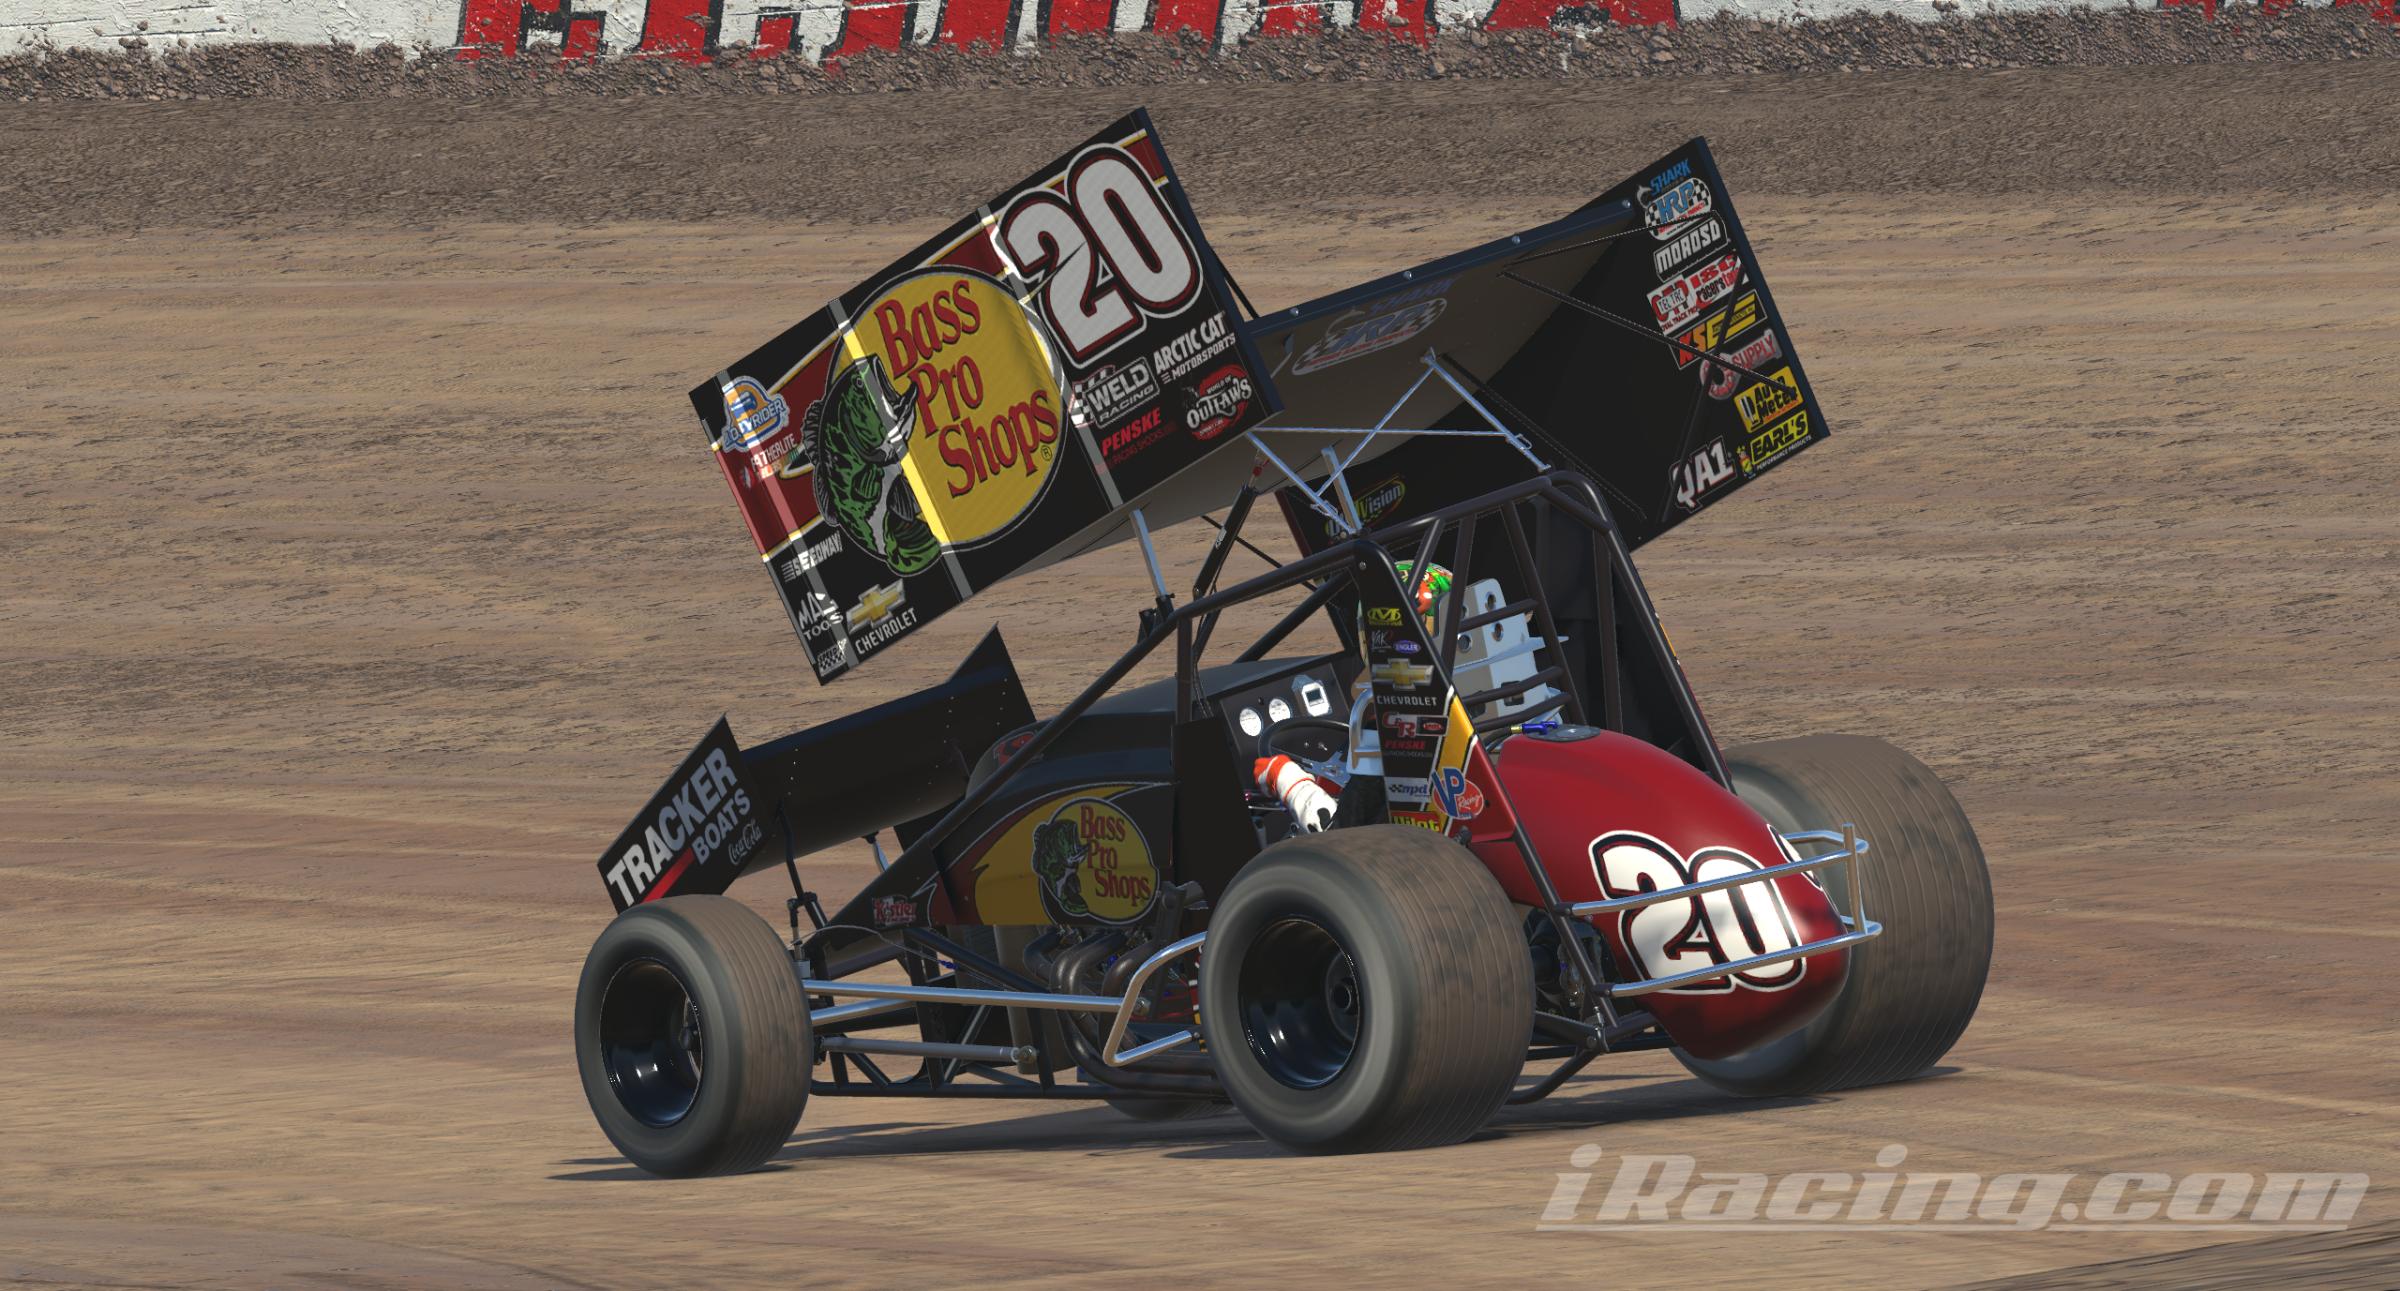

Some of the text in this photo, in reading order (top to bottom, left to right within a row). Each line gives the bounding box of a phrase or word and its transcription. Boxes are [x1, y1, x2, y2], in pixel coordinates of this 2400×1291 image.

[1650, 159, 1692, 196] SHARK
[991, 143, 1204, 368] 20
[1656, 220, 1720, 274] MOROSO
[874, 280, 980, 379] Bass
[1154, 313, 1228, 375] ARCTIC CAT
[1731, 334, 1775, 370] SUPPLY
[1171, 332, 1236, 381] MOTORSPORTS
[908, 355, 984, 439] Pro
[1087, 363, 1149, 412] WELD
[1100, 384, 1154, 423] RACING
[938, 389, 1059, 498] Shops
[1102, 407, 1162, 457] PENSKE
[1751, 415, 1807, 461] EARL'S
[1672, 441, 1734, 508] QA1
[792, 531, 843, 576] SEEDWAY
[804, 611, 843, 641] TOOS
[855, 608, 918, 654] CHEVROLET
[1376, 695, 1437, 706] CHEVROLET
[1431, 767, 1465, 818] VP
[607, 748, 737, 907] TRACKER
[691, 788, 750, 865] BOATS
[1080, 804, 1126, 842] Bass
[1087, 840, 1118, 869] Pro
[1094, 868, 1152, 907] Shops
[1588, 830, 1807, 994] 20
